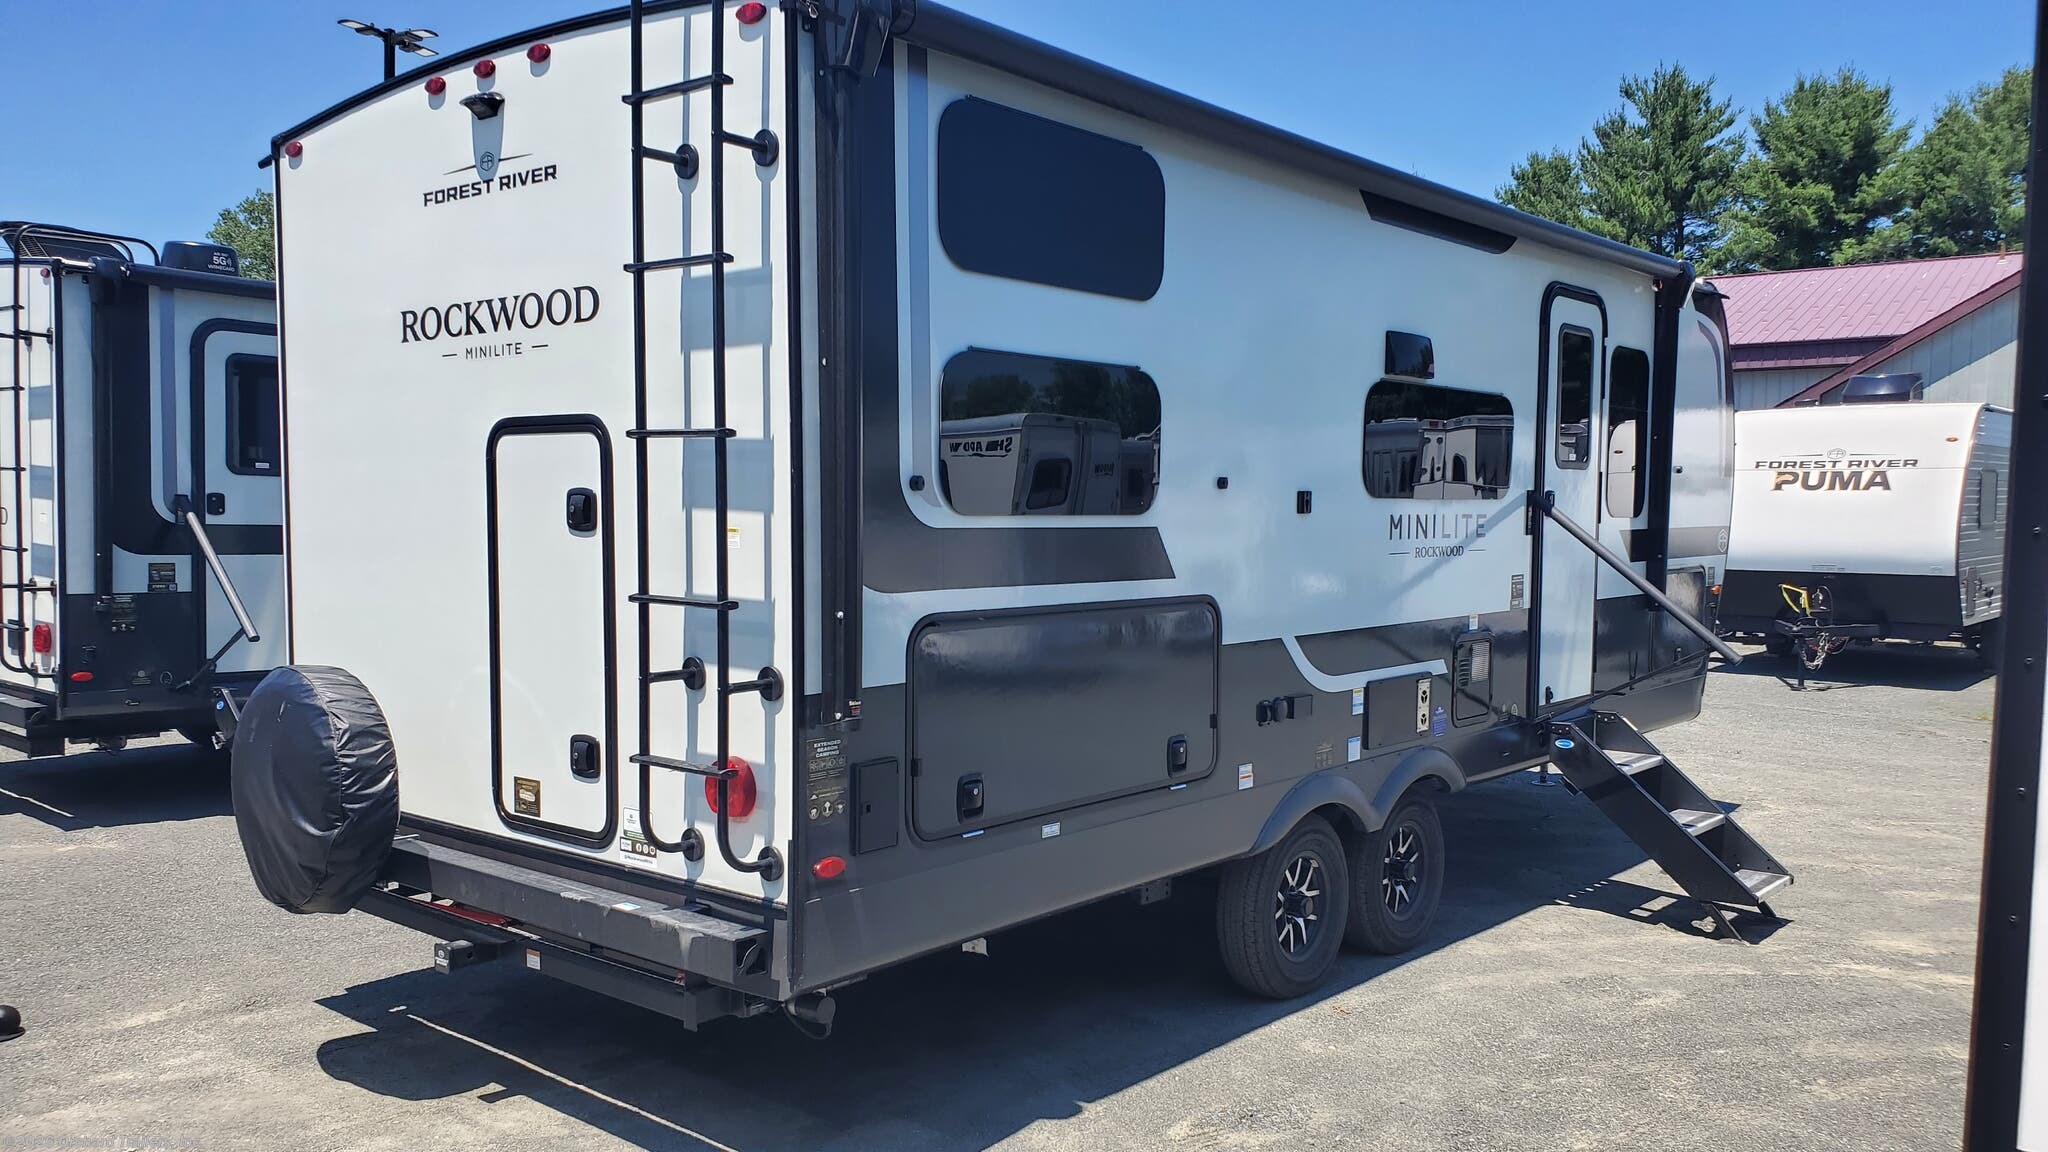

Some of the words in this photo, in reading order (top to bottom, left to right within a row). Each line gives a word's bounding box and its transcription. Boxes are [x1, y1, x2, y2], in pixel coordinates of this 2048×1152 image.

[423, 178, 494, 207] FOREST
[499, 164, 557, 192] RIVER
[213, 256, 227, 265] 5G
[401, 285, 600, 343] ROCKWOOD
[465, 342, 522, 360] MINILITE
[1755, 460, 1842, 469] FOREST
[1847, 459, 1918, 468] RIVER
[1771, 470, 1891, 491] PUMA
[1389, 513, 1488, 540] MINILITE
[1414, 545, 1464, 558] ROCKWOOD
[813, 739, 841, 748] EXTENDED
[815, 750, 840, 758] CAMPING
